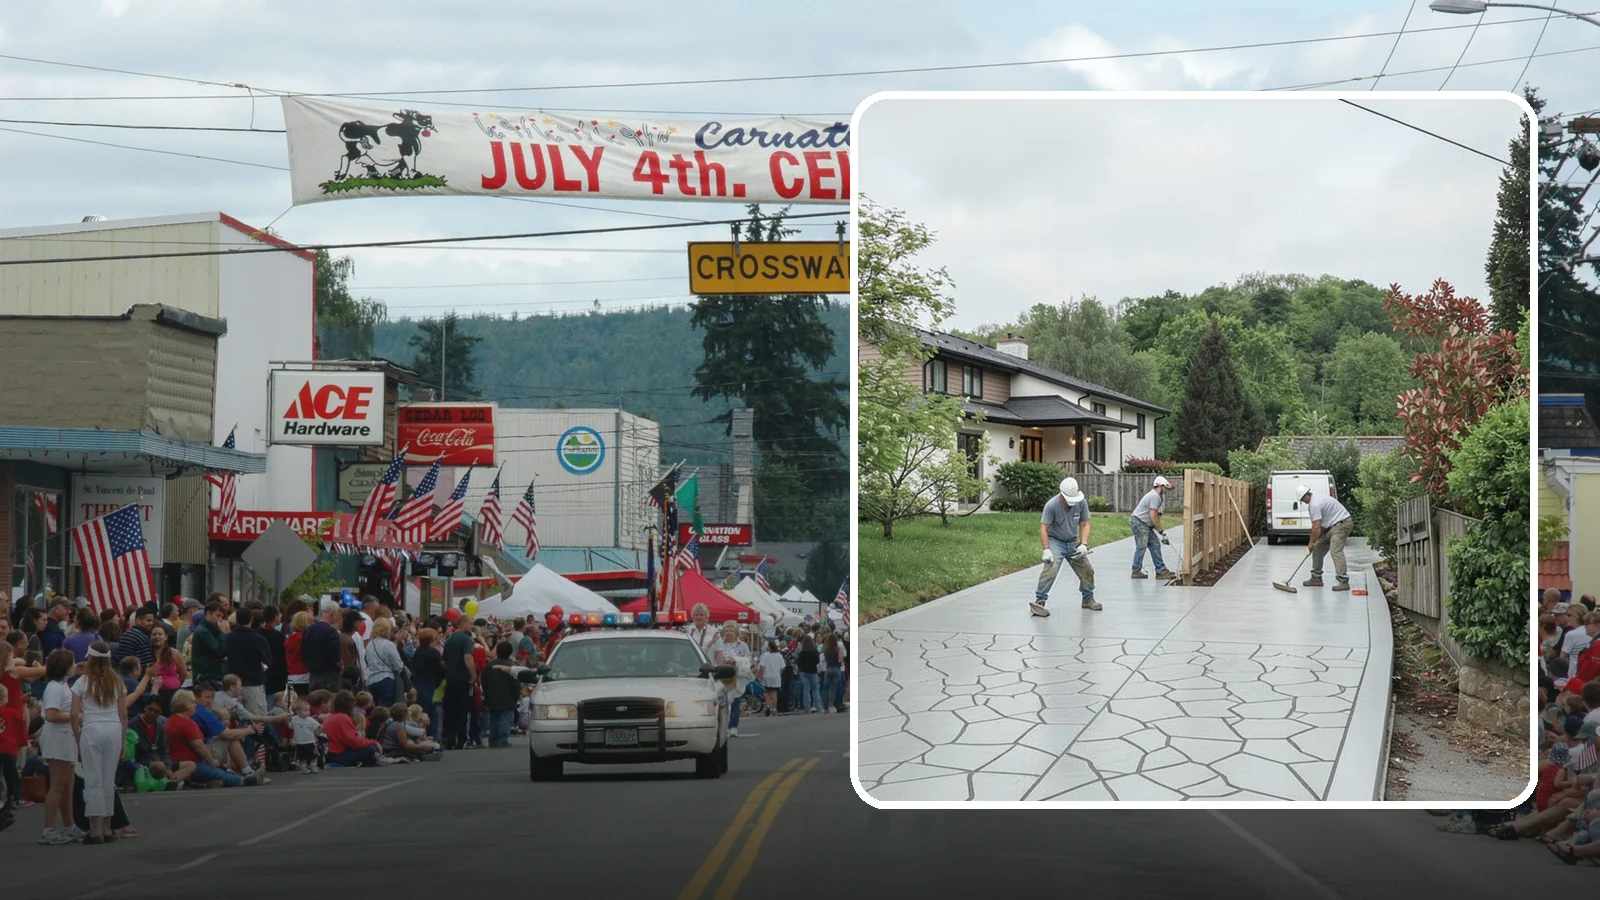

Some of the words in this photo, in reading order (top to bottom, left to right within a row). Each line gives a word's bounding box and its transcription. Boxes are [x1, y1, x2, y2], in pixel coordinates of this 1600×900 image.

[481, 141, 605, 192] JULY
[632, 150, 746, 197] 4th.
[697, 254, 850, 279] CROSSWA
[283, 380, 373, 420] ACE
[406, 410, 453, 422] CEDAR
[461, 409, 485, 422] LOG
[283, 421, 370, 436] Hardware
[417, 428, 477, 446] Coca-Cola
[353, 467, 385, 480] Simpl
[95, 484, 124, 494] Vincent
[126, 486, 136, 494] de
[137, 486, 155, 495] Paul
[688, 526, 741, 535] CRNATION
[699, 535, 730, 543] GLASS
